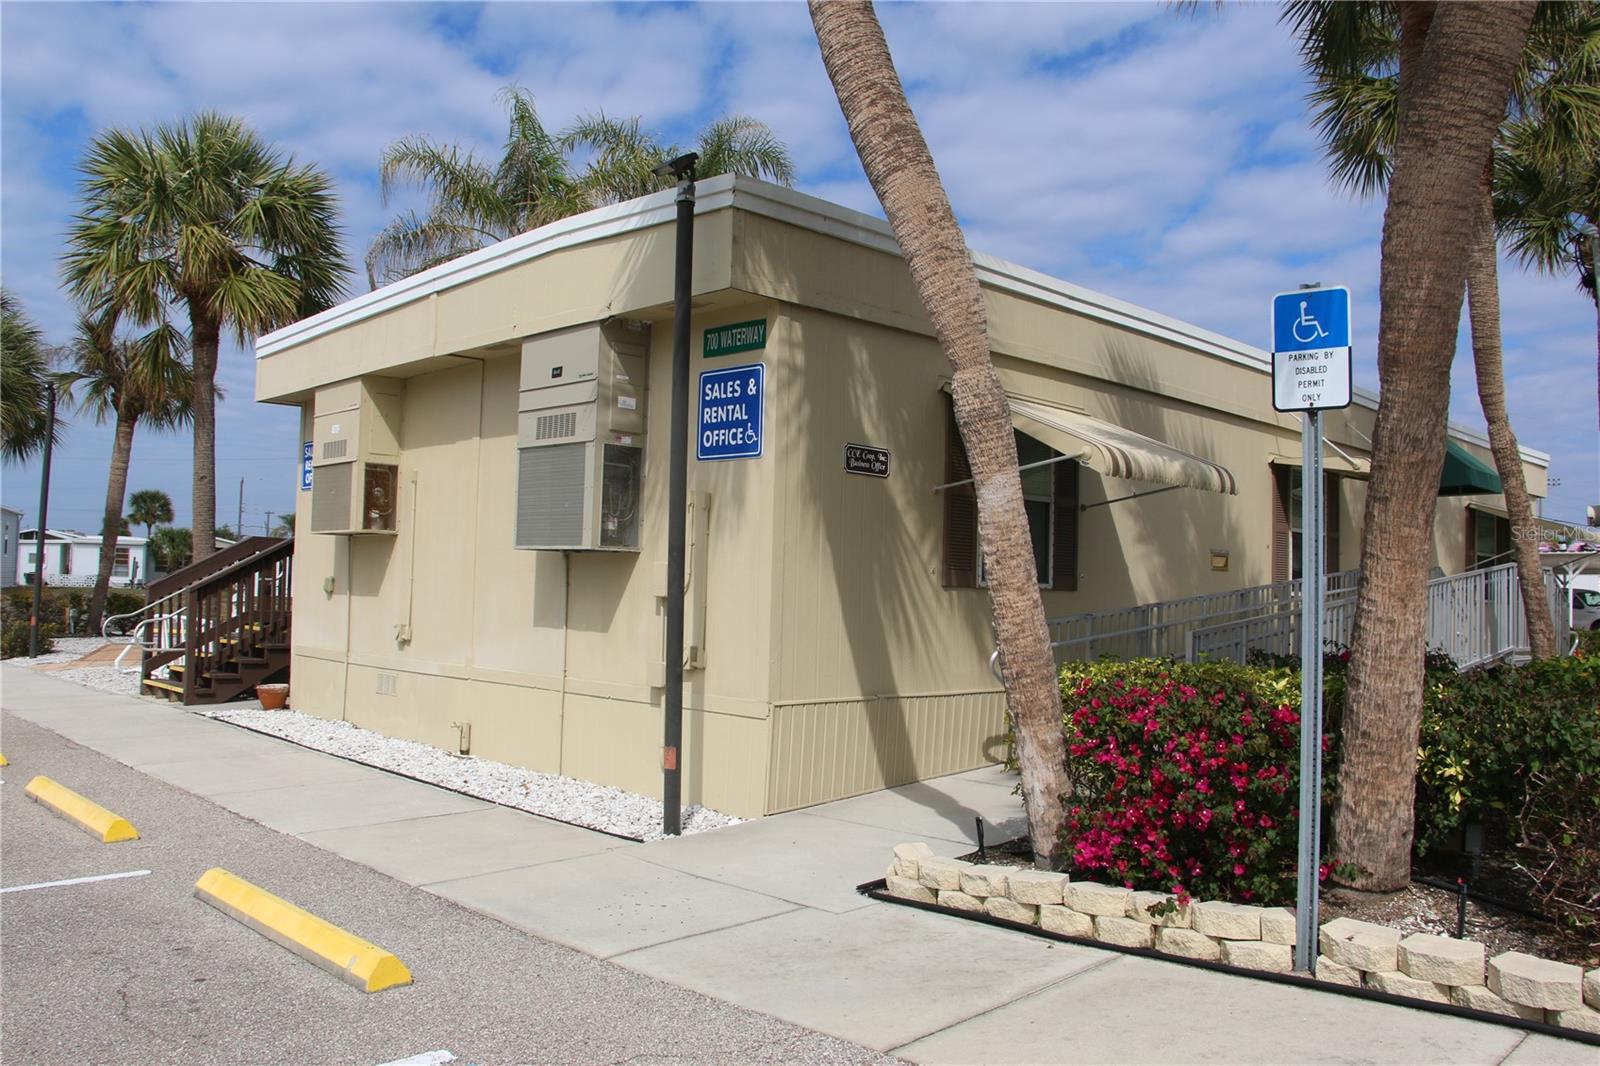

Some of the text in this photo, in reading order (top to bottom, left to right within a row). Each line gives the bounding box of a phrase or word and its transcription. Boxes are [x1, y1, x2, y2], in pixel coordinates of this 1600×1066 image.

[706, 325, 764, 350] 700 WATERWAY
[1288, 352, 1334, 362] PARKING BY
[1295, 365, 1328, 375] DISABLED
[705, 378, 757, 400] SALES &
[1298, 380, 1325, 388] PERMIT
[1302, 394, 1321, 402] ONLY
[704, 403, 748, 424] RENTAL
[703, 428, 744, 447] OFFICE
